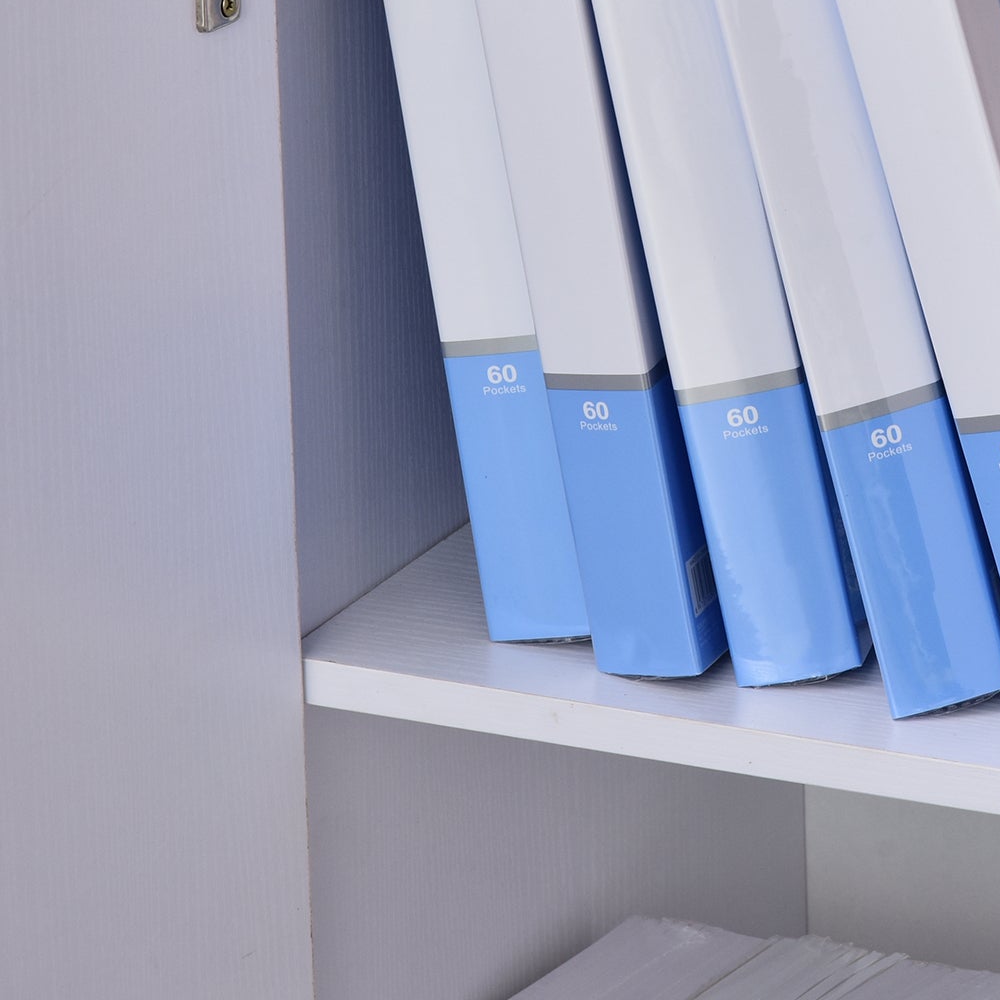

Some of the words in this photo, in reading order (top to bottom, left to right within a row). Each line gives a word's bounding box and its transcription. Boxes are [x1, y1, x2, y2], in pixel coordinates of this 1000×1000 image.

[486, 363, 518, 386] 60
[482, 381, 526, 396] Pockets
[583, 401, 609, 421] 60
[727, 405, 758, 428] 60
[579, 419, 618, 432] Pockets
[723, 424, 768, 440] Pockets
[871, 424, 902, 448] 60
[867, 442, 913, 463] Pockets
